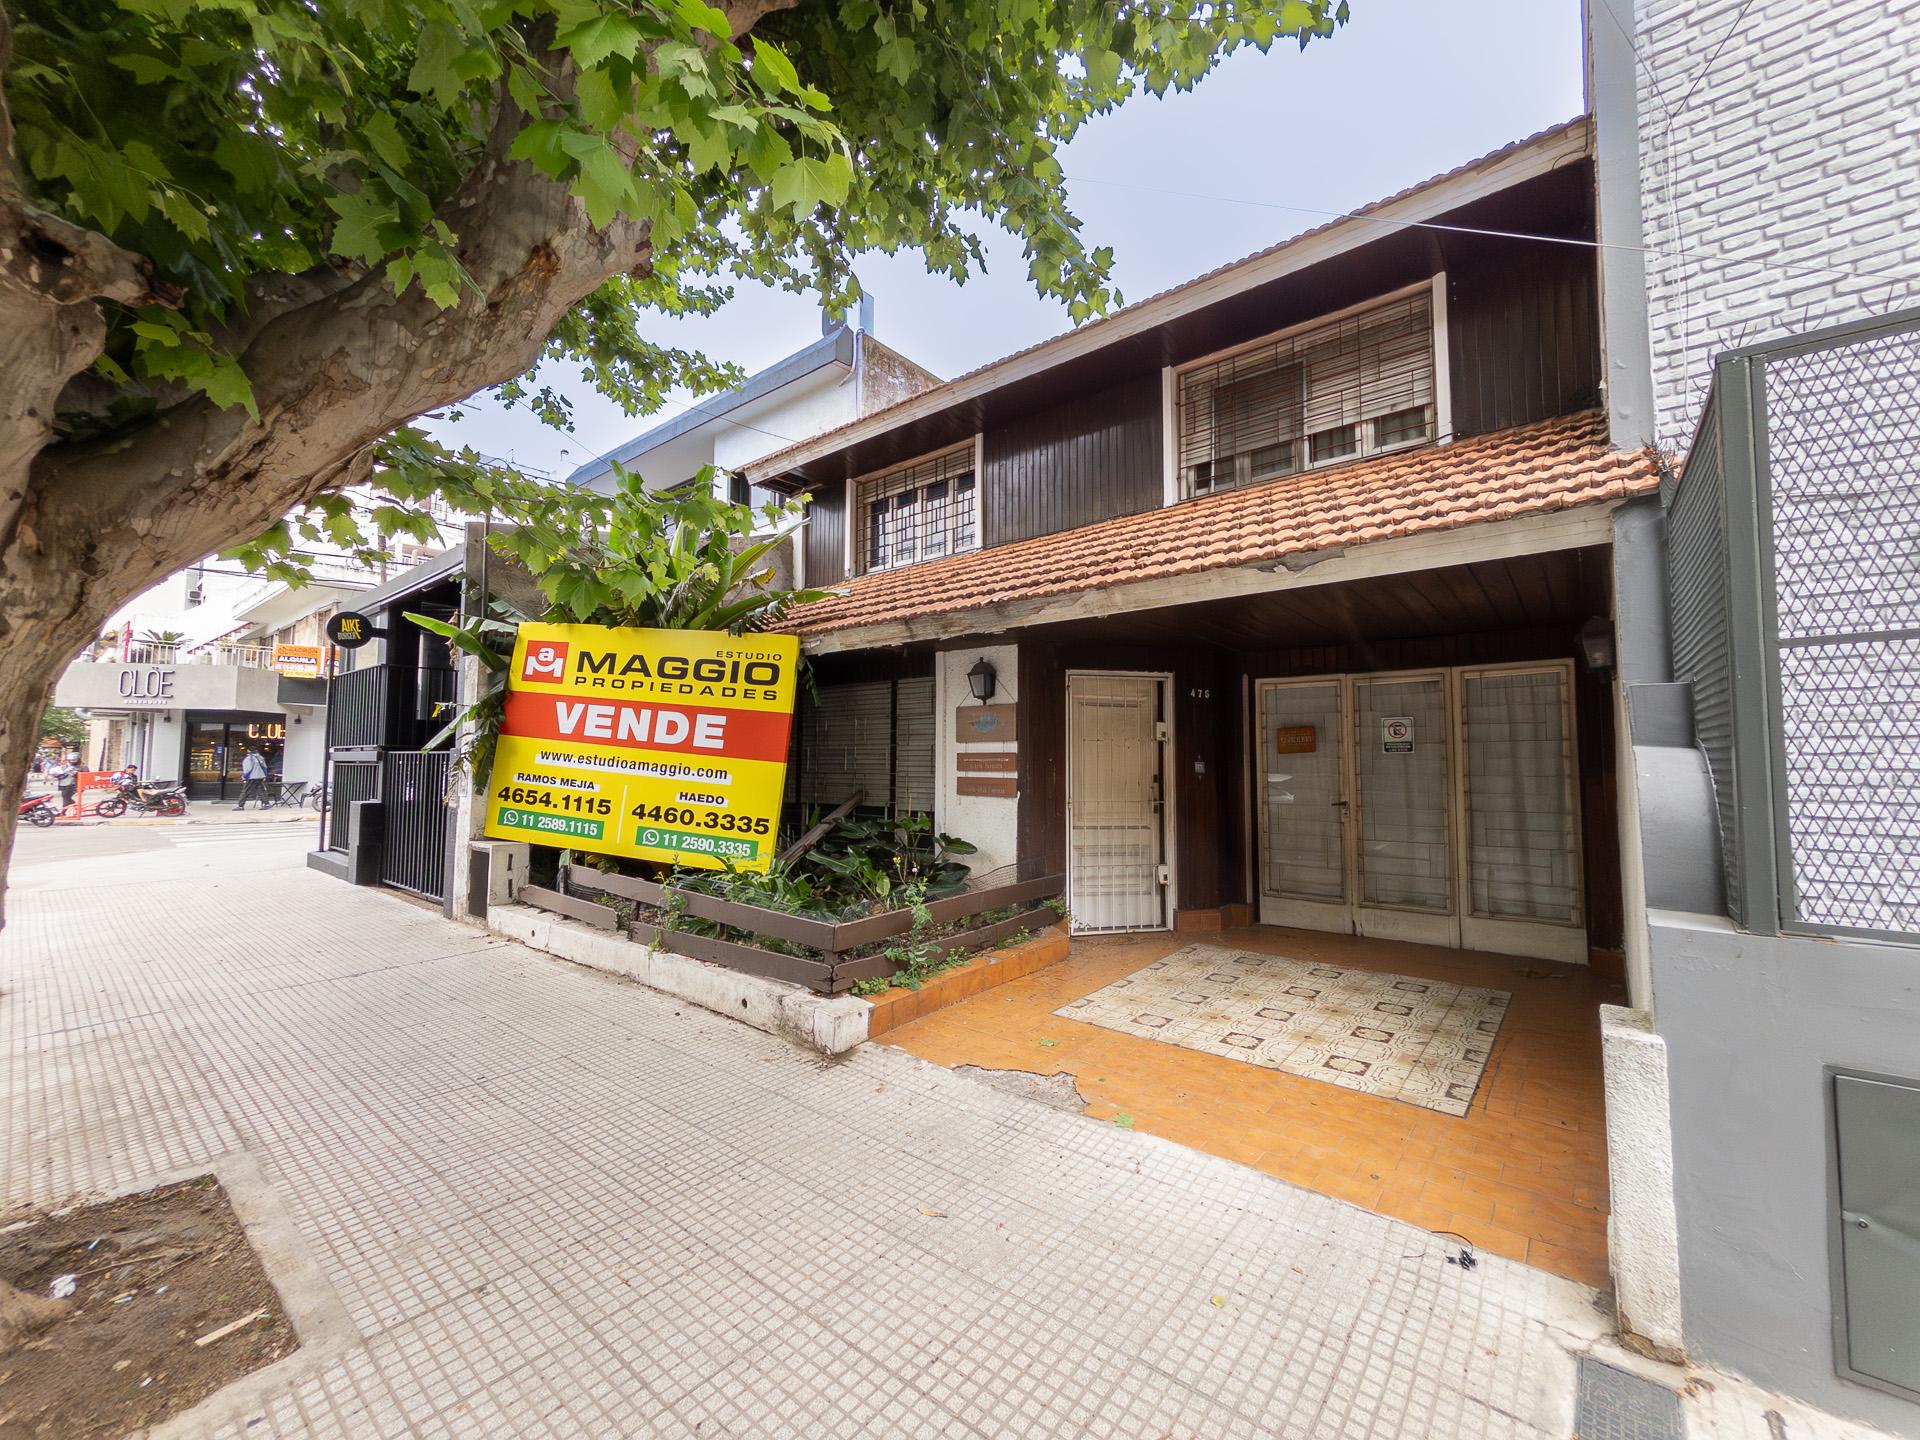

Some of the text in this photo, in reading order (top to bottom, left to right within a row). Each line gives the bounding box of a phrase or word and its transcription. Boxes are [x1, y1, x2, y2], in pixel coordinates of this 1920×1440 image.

[341, 618, 362, 639] AIKE
[278, 655, 317, 665] ALQUILA
[716, 650, 783, 661] ESTUDIO
[576, 650, 781, 686] MAGGIO
[574, 676, 778, 701] PROPIEDADES
[555, 701, 727, 750] VENDE
[540, 750, 729, 780] www.estudioamaggio.com
[517, 772, 595, 790] RAMOS MEJIA
[497, 786, 612, 816] 4654.1115
[679, 791, 725, 805] HAEDO
[521, 814, 598, 836] 11 2589.1115
[631, 803, 770, 835] 4460.3335
[663, 833, 751, 857] 11 2590.3335
